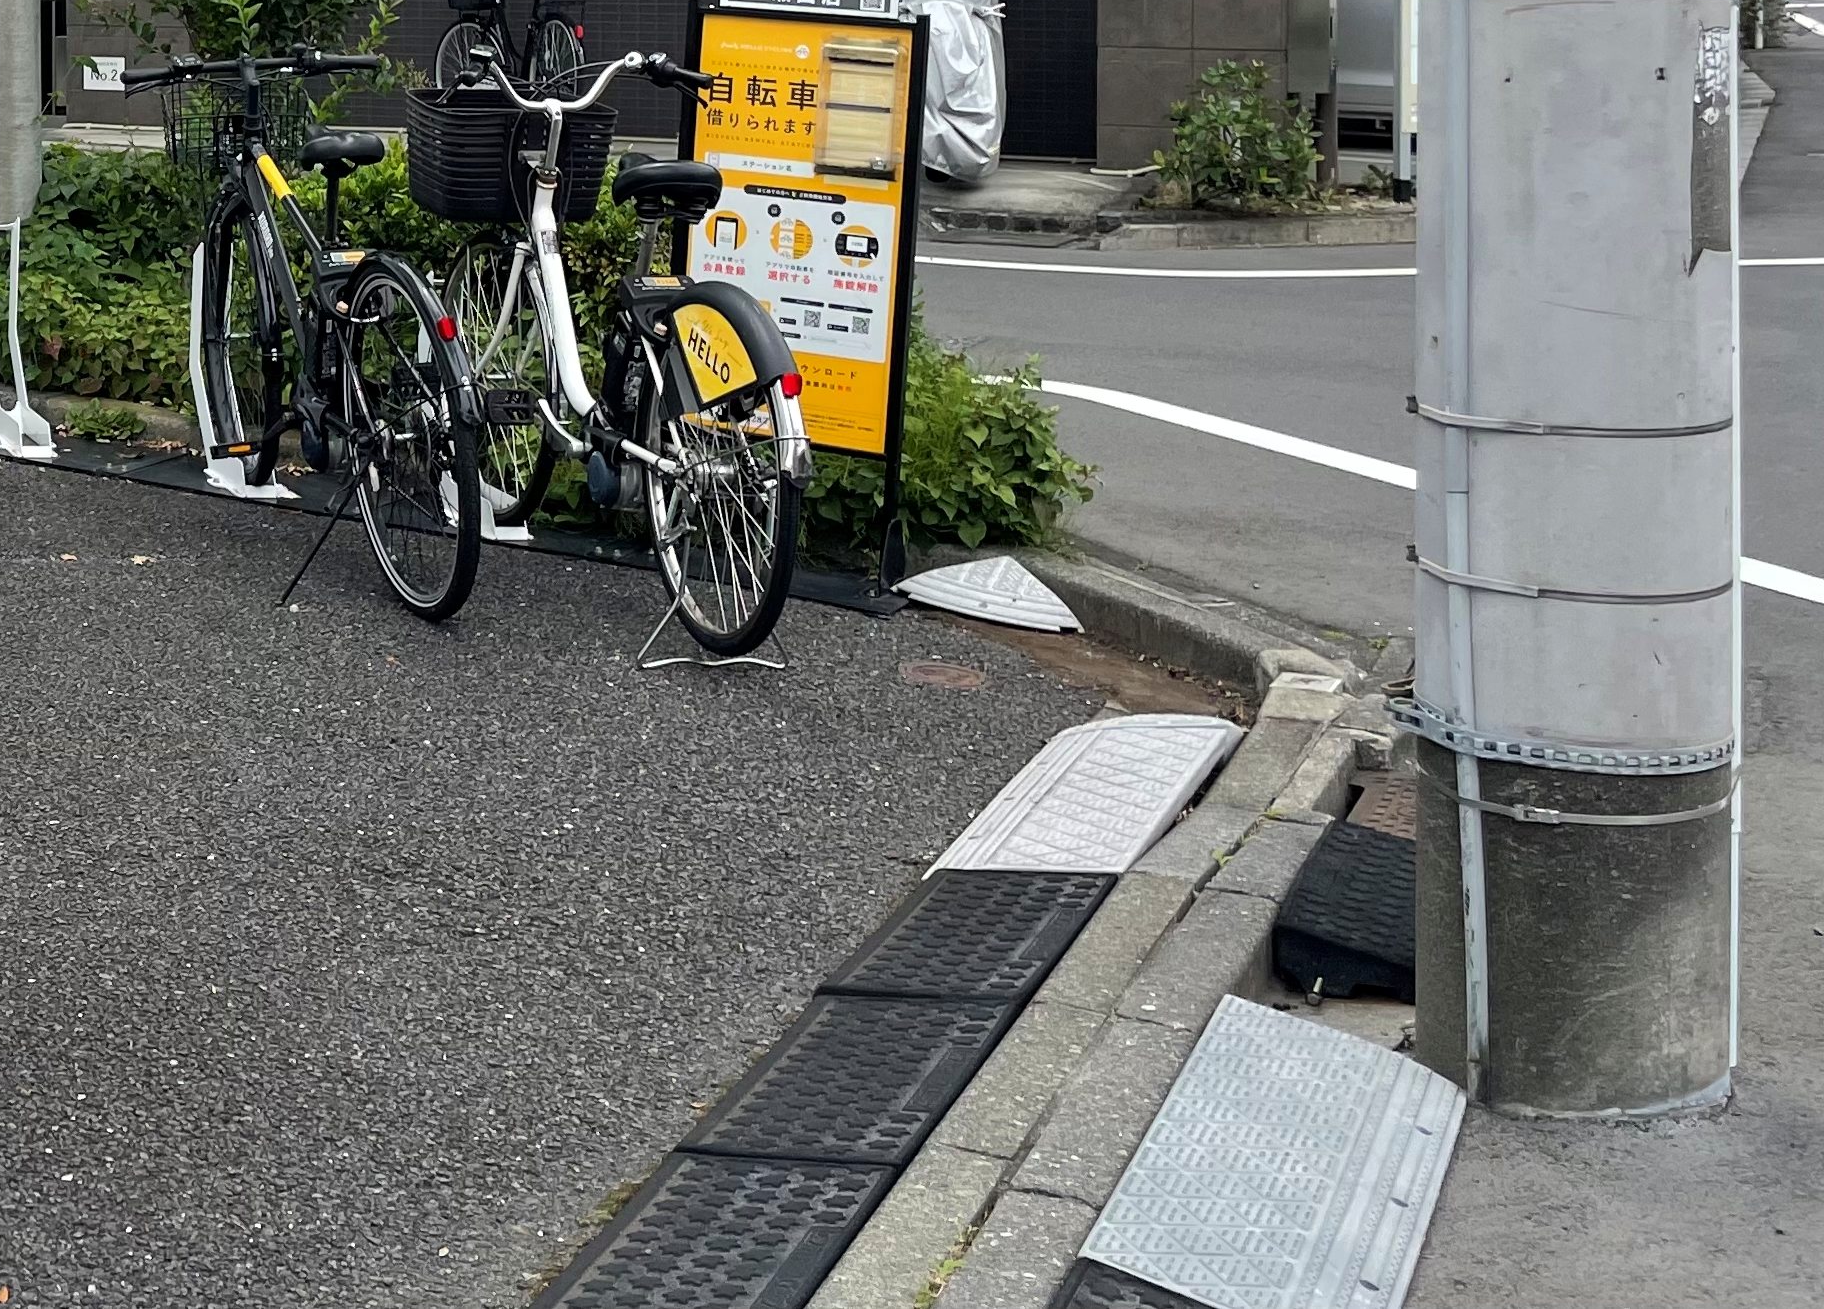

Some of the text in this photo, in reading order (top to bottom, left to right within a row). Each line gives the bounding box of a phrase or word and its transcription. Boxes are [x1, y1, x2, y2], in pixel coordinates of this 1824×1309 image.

[709, 72, 818, 111] 自転車
[707, 108, 816, 135] 借りられます
[767, 271, 811, 284] 選択する
[688, 327, 730, 384] HELLO
